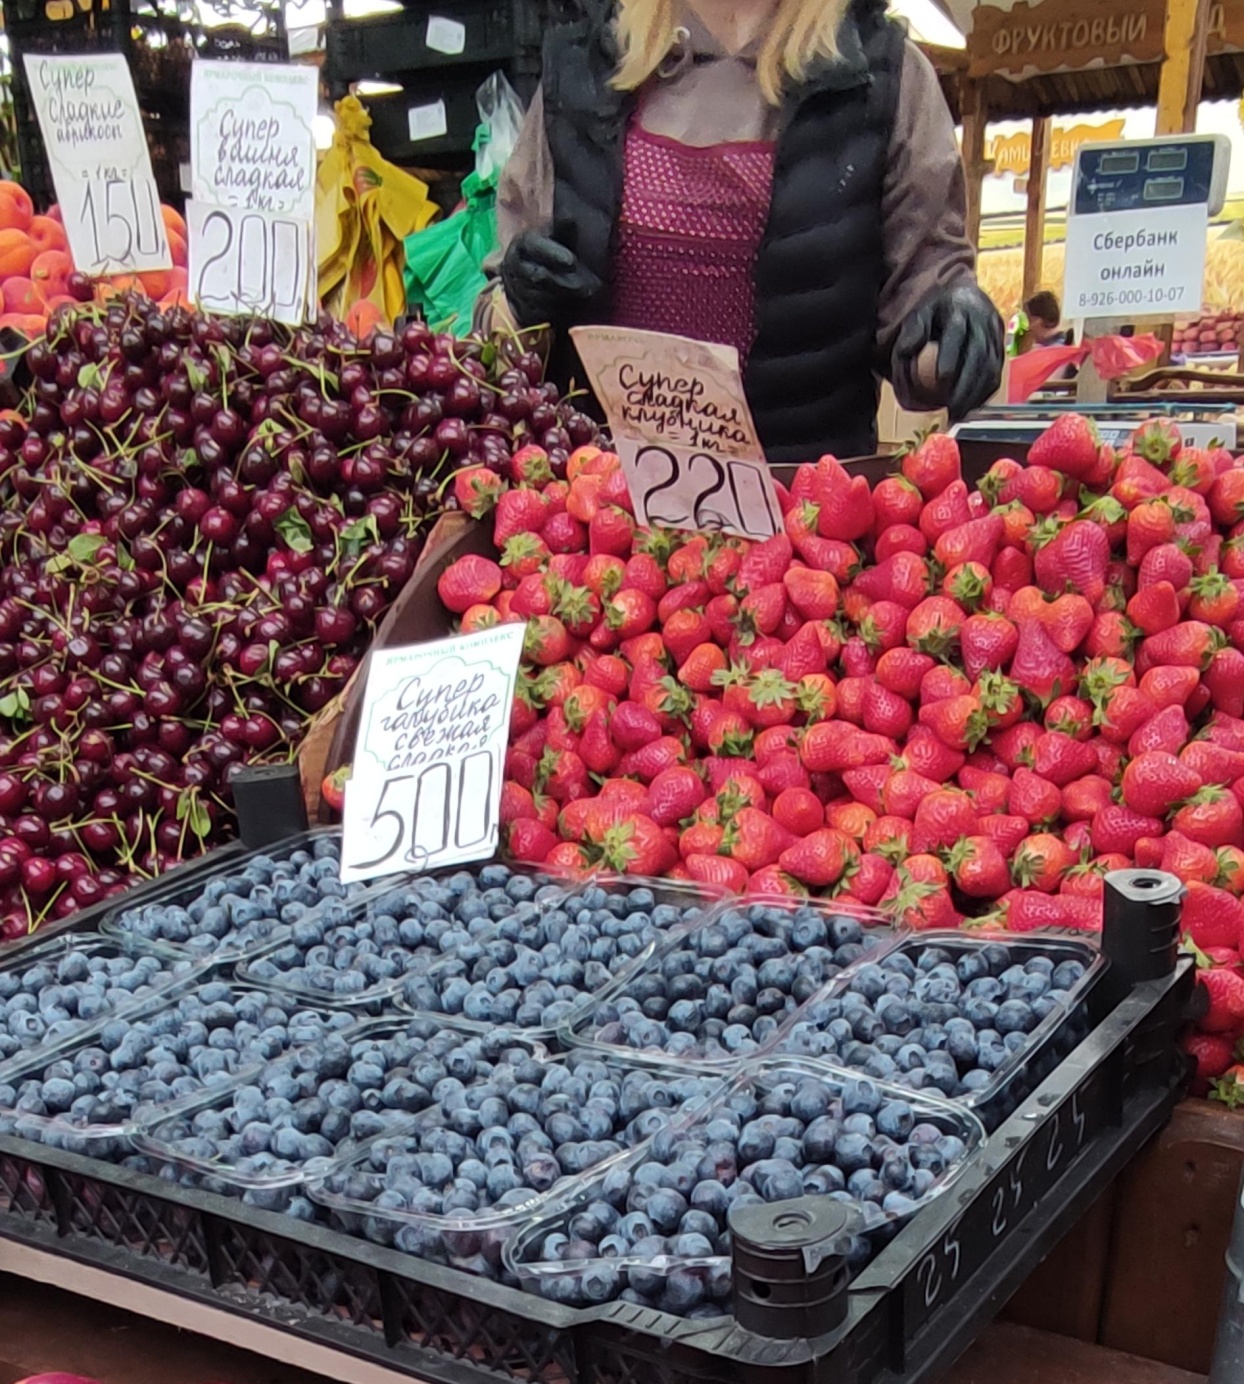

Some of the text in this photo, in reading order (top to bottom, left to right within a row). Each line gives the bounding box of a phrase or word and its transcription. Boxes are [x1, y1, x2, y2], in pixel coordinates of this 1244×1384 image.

[992, 8, 1148, 54] ФРУКТОВЫЙ
[40, 59, 95, 97] Супер
[219, 109, 280, 149] Супер
[214, 165, 304, 193] сладкая
[198, 211, 299, 307] 200
[1093, 228, 1179, 253] Сбербанк
[1100, 259, 1165, 281] онлайн
[1079, 286, 1185, 307] 8-926-000-10-07
[619, 363, 705, 401] Супер
[626, 390, 742, 427] сладкая
[635, 445, 777, 537] 220
[396, 673, 485, 711] Супер
[394, 714, 491, 750] свежая
[347, 750, 493, 869] 500
